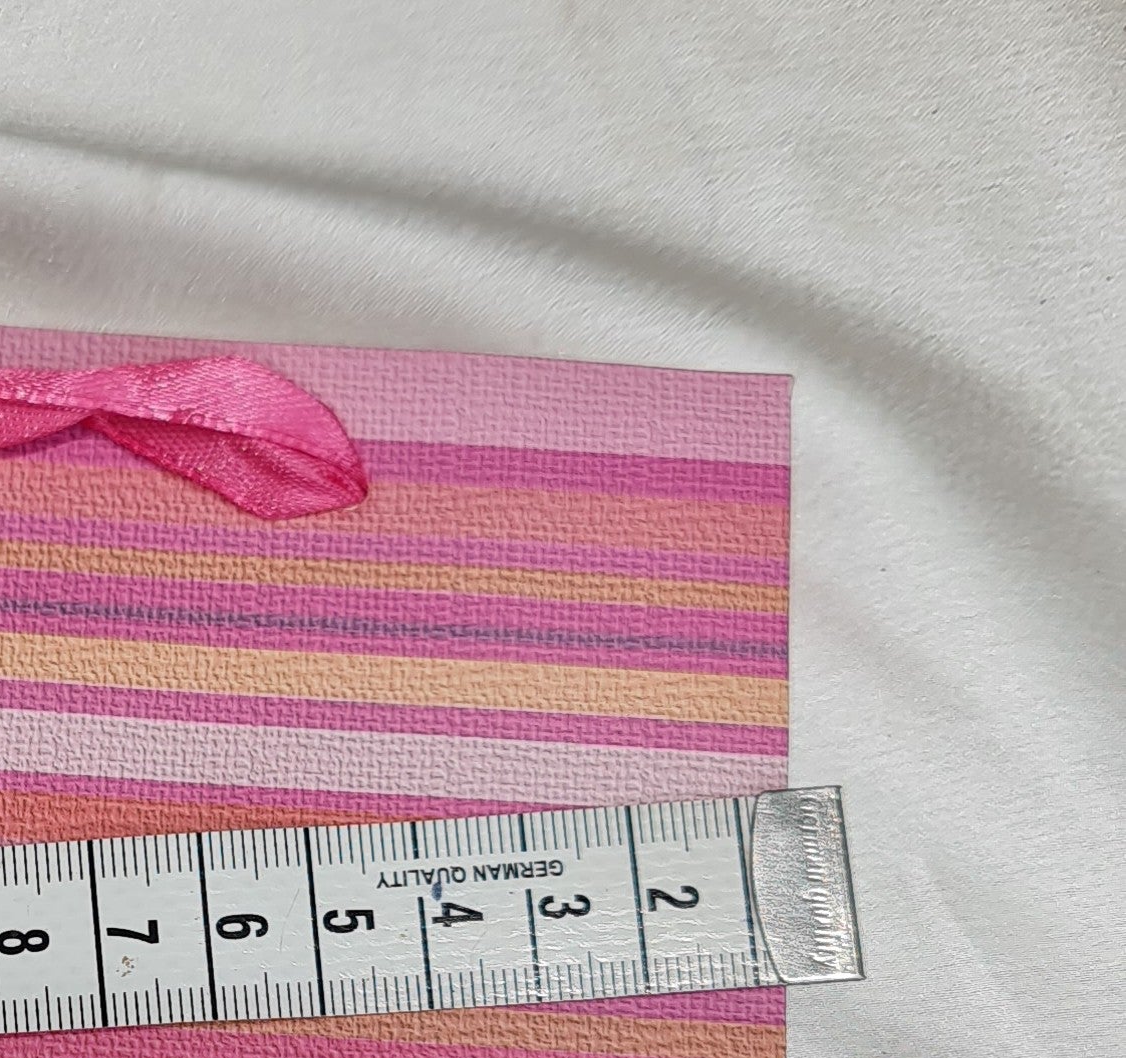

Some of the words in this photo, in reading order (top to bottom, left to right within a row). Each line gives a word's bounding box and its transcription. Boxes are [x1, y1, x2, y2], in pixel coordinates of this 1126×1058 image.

[376, 865, 467, 888] QUALITY
[474, 860, 564, 882] GERMAN
[539, 894, 591, 919] 3
[648, 885, 700, 912] 2
[215, 913, 269, 940] 6
[322, 909, 375, 934] 5
[432, 902, 483, 928] 4
[106, 919, 160, 944] 7
